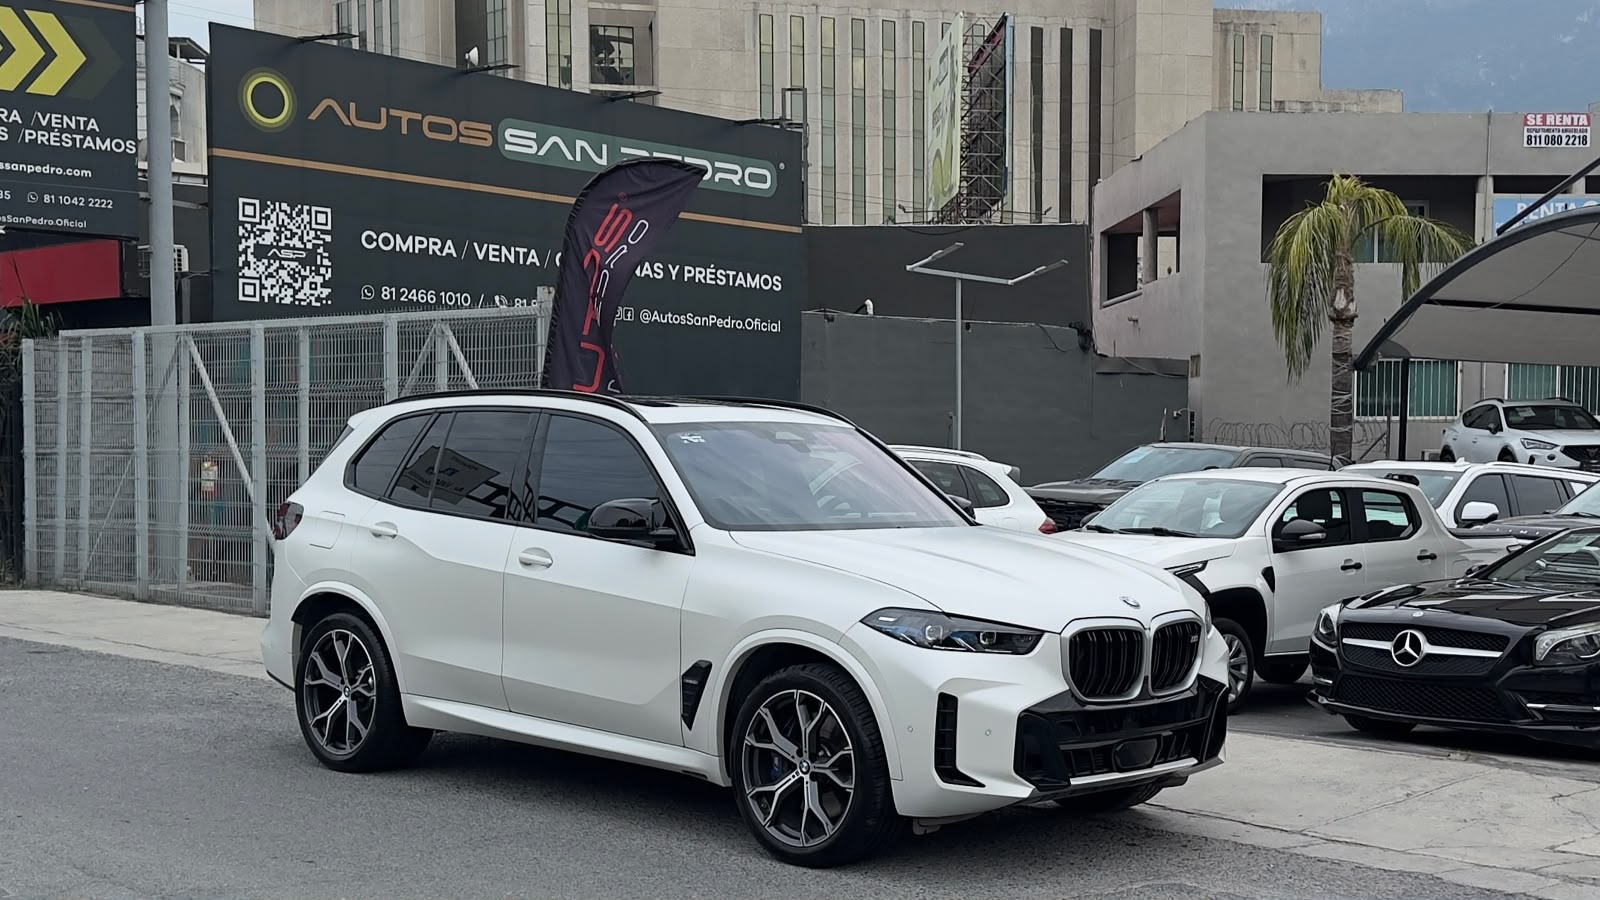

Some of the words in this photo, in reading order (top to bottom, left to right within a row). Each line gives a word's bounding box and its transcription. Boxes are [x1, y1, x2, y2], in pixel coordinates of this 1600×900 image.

[1526, 113, 1543, 126] SE
[1546, 113, 1589, 126] RENTA
[307, 98, 493, 147] AUTOS
[503, 127, 607, 166] SAN
[1526, 134, 1542, 146] 811
[1544, 134, 1563, 146] 080
[1565, 134, 1588, 146] 2218
[43, 193, 56, 204] 81
[59, 195, 85, 207] 1042
[88, 197, 114, 209] 2222
[267, 248, 306, 258] ASP
[360, 229, 458, 258] COMPRA
[473, 241, 541, 267] VENTA
[668, 264, 681, 281] Y
[684, 264, 783, 292] PRÉSTAMOS
[381, 286, 396, 300] 81
[399, 287, 437, 304] 2466
[439, 291, 471, 306] 1010
[639, 309, 782, 333] @AutosSanPedro.Oficial
